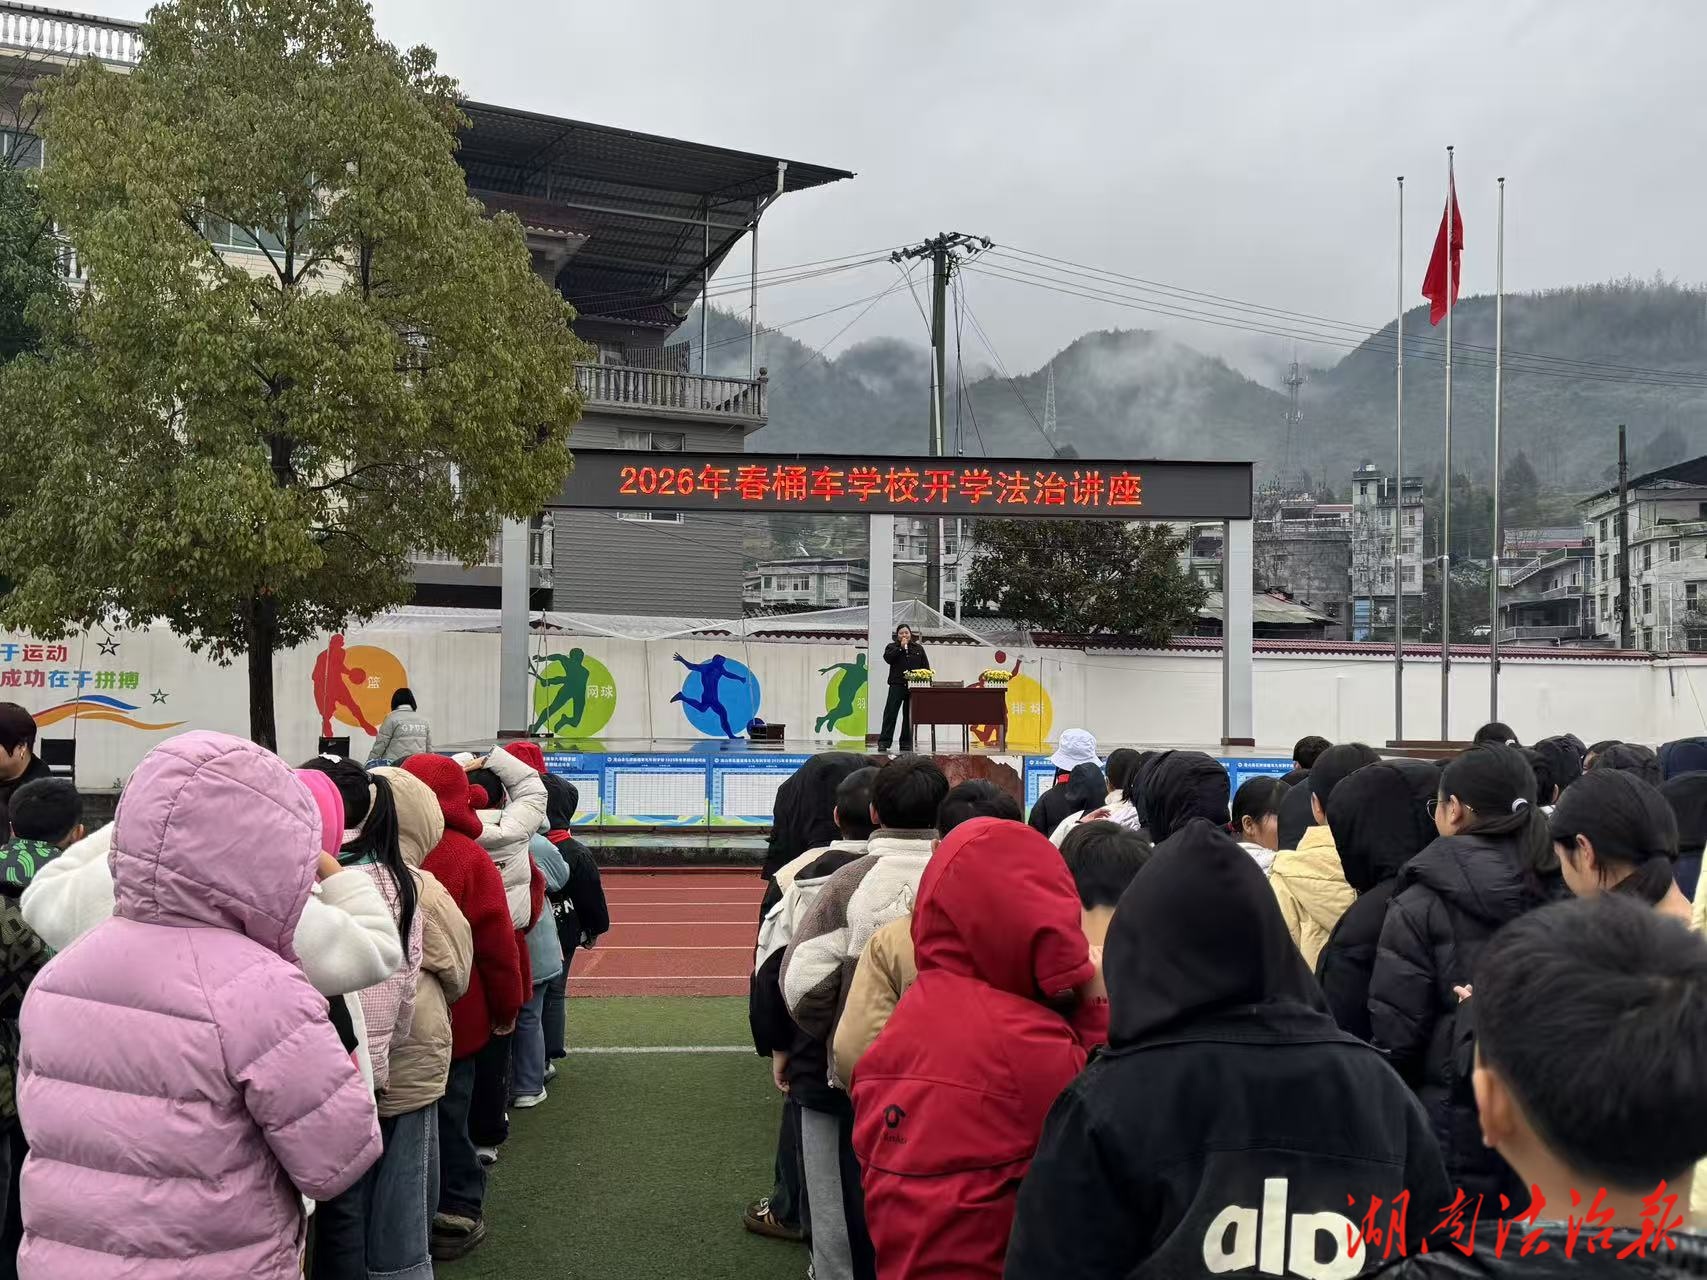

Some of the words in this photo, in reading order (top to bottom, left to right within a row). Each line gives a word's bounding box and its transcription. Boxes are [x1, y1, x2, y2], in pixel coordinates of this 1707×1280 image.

[619, 463, 1142, 506] 2026年春桶车学校开学法治讲座
[0, 643, 67, 662] 于运动
[0, 668, 140, 689] 成功在于拼搏
[587, 685, 613, 698] 网球
